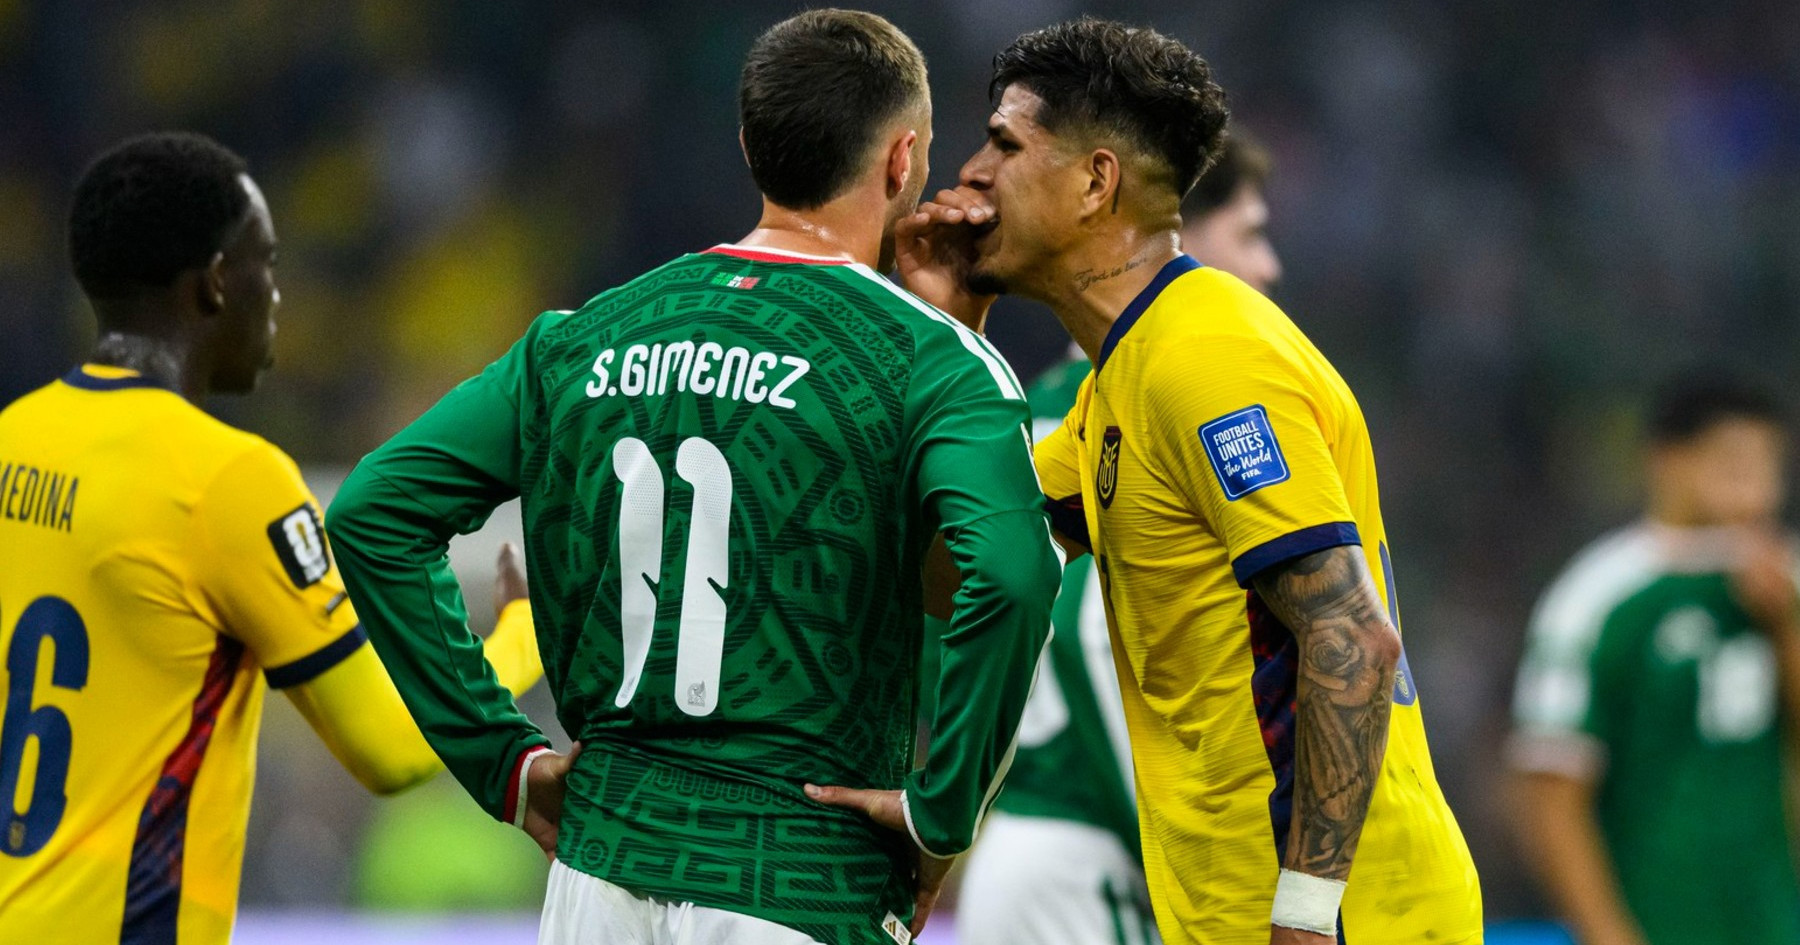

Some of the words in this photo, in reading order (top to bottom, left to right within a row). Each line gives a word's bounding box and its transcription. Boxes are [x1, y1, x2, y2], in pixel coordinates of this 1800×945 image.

[585, 340, 810, 409] S.GIMENEZ
[1213, 420, 1259, 446] FOOTBALL
[1218, 432, 1265, 462] UNITES
[1224, 462, 1241, 477] the
[1239, 447, 1272, 469] World
[1241, 468, 1262, 480] FIFA
[612, 436, 733, 717] 11
